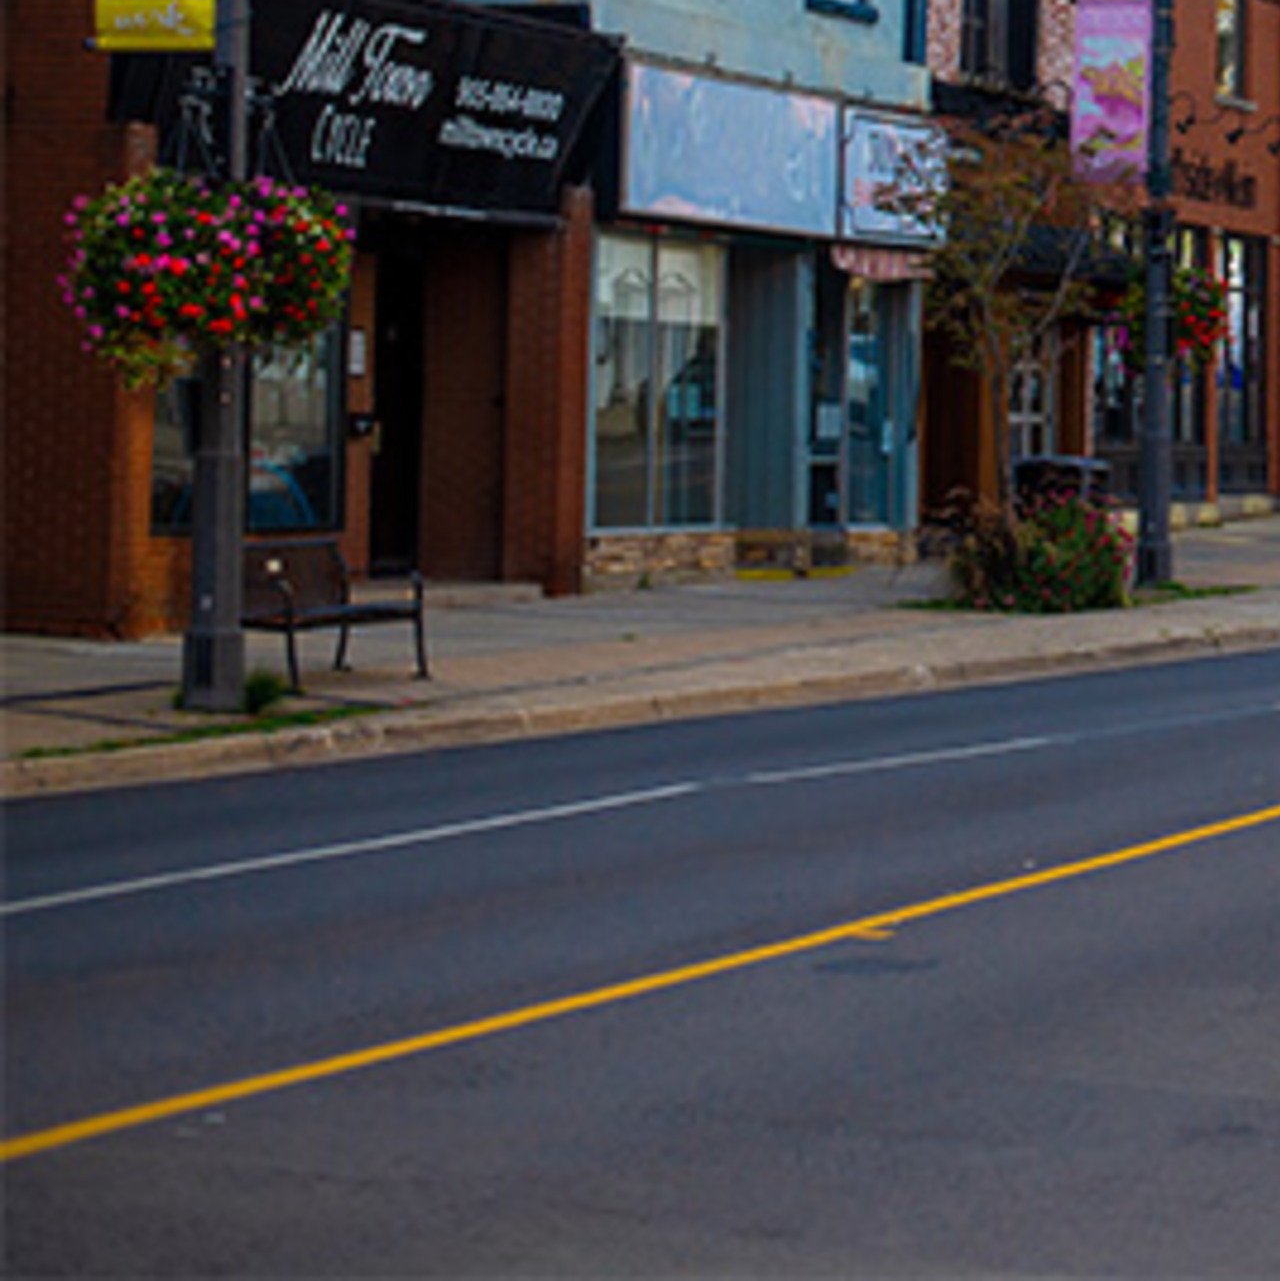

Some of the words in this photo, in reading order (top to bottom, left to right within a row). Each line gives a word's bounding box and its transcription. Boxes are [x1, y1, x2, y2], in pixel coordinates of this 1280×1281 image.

[273, 12, 370, 95] Mill
[350, 23, 433, 109] Town
[311, 104, 376, 167] CYCLE
